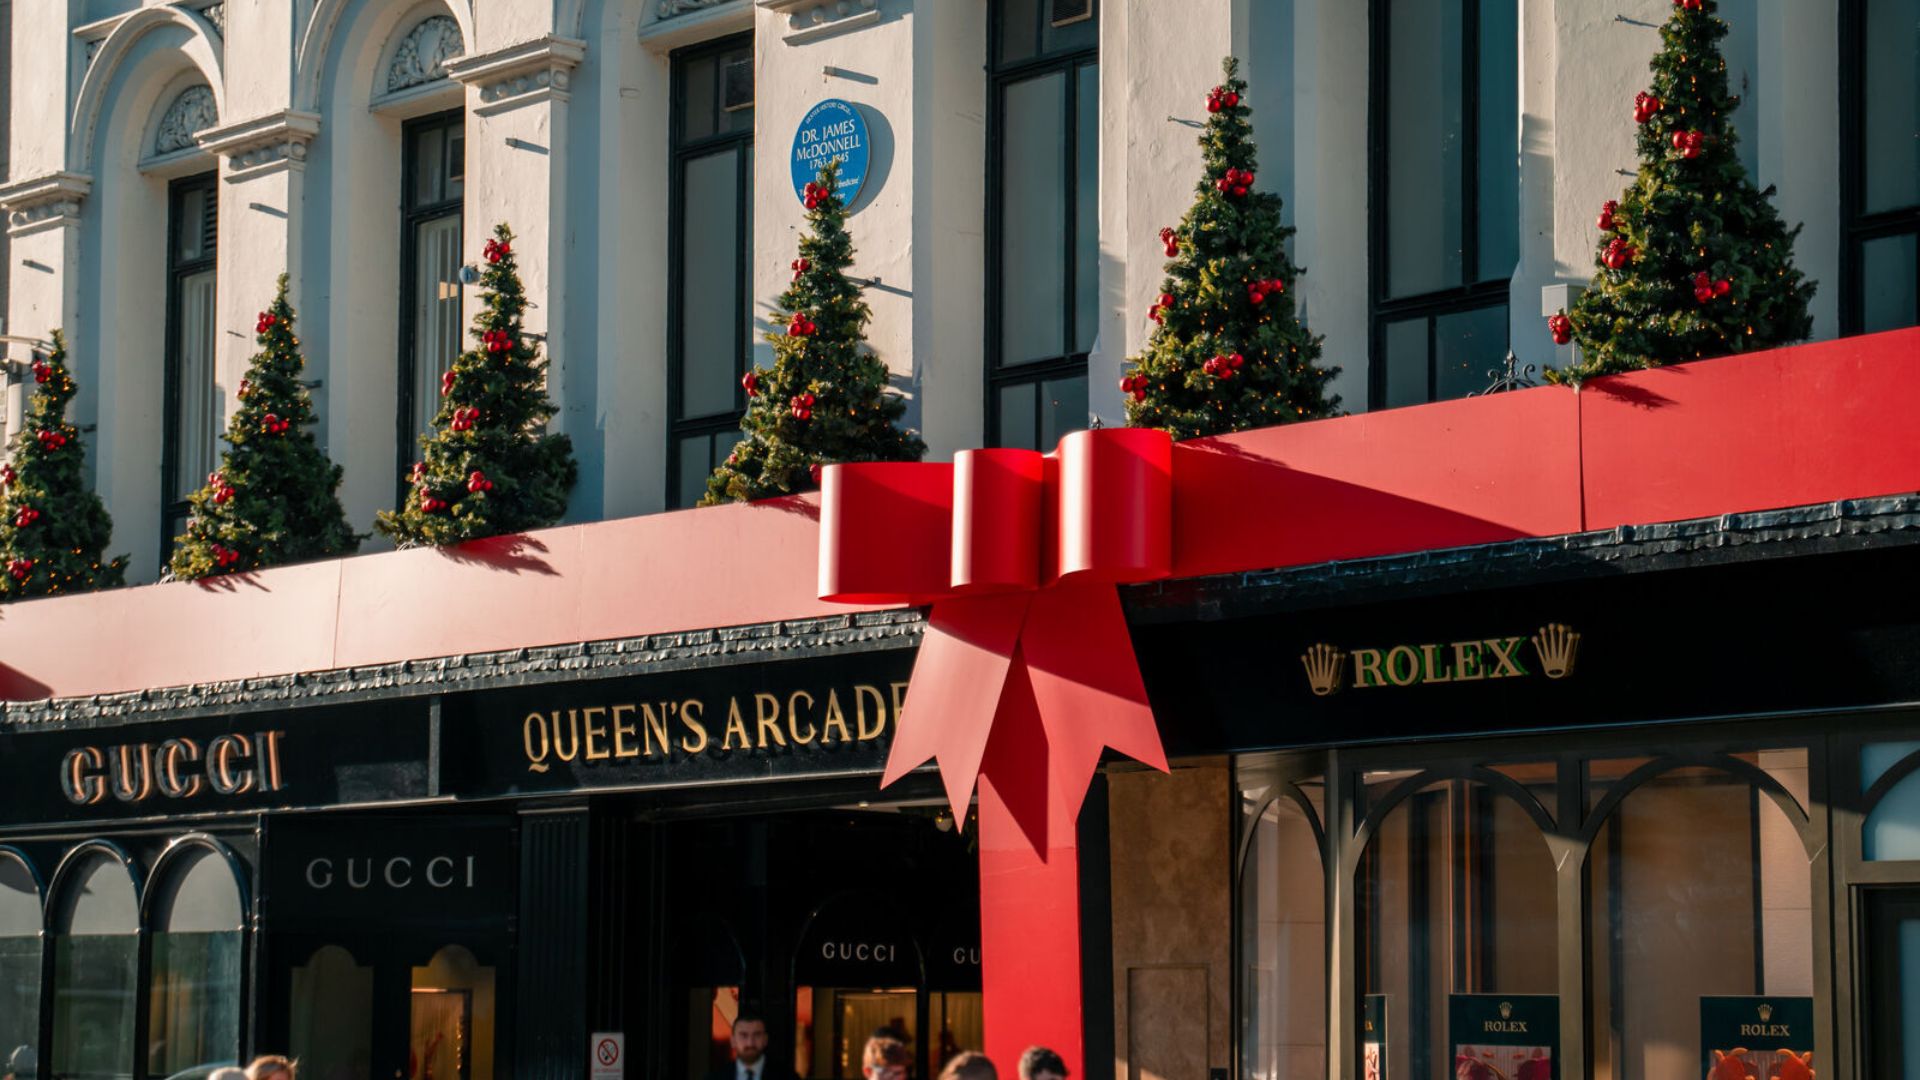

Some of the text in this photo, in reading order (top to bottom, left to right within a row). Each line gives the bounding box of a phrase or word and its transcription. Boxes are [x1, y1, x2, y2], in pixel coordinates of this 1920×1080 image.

[801, 118, 856, 144] DR. JAMES
[796, 134, 862, 162] McDONNELL
[1350, 636, 1529, 689] ROLEX
[523, 698, 709, 774] QUEEN'S
[60, 730, 285, 805] GUCCI
[305, 855, 474, 889] GUCCI
[822, 941, 895, 963] GUCCI
[1483, 1020, 1529, 1033] ROLEX
[1740, 1023, 1791, 1037] ROLEX
